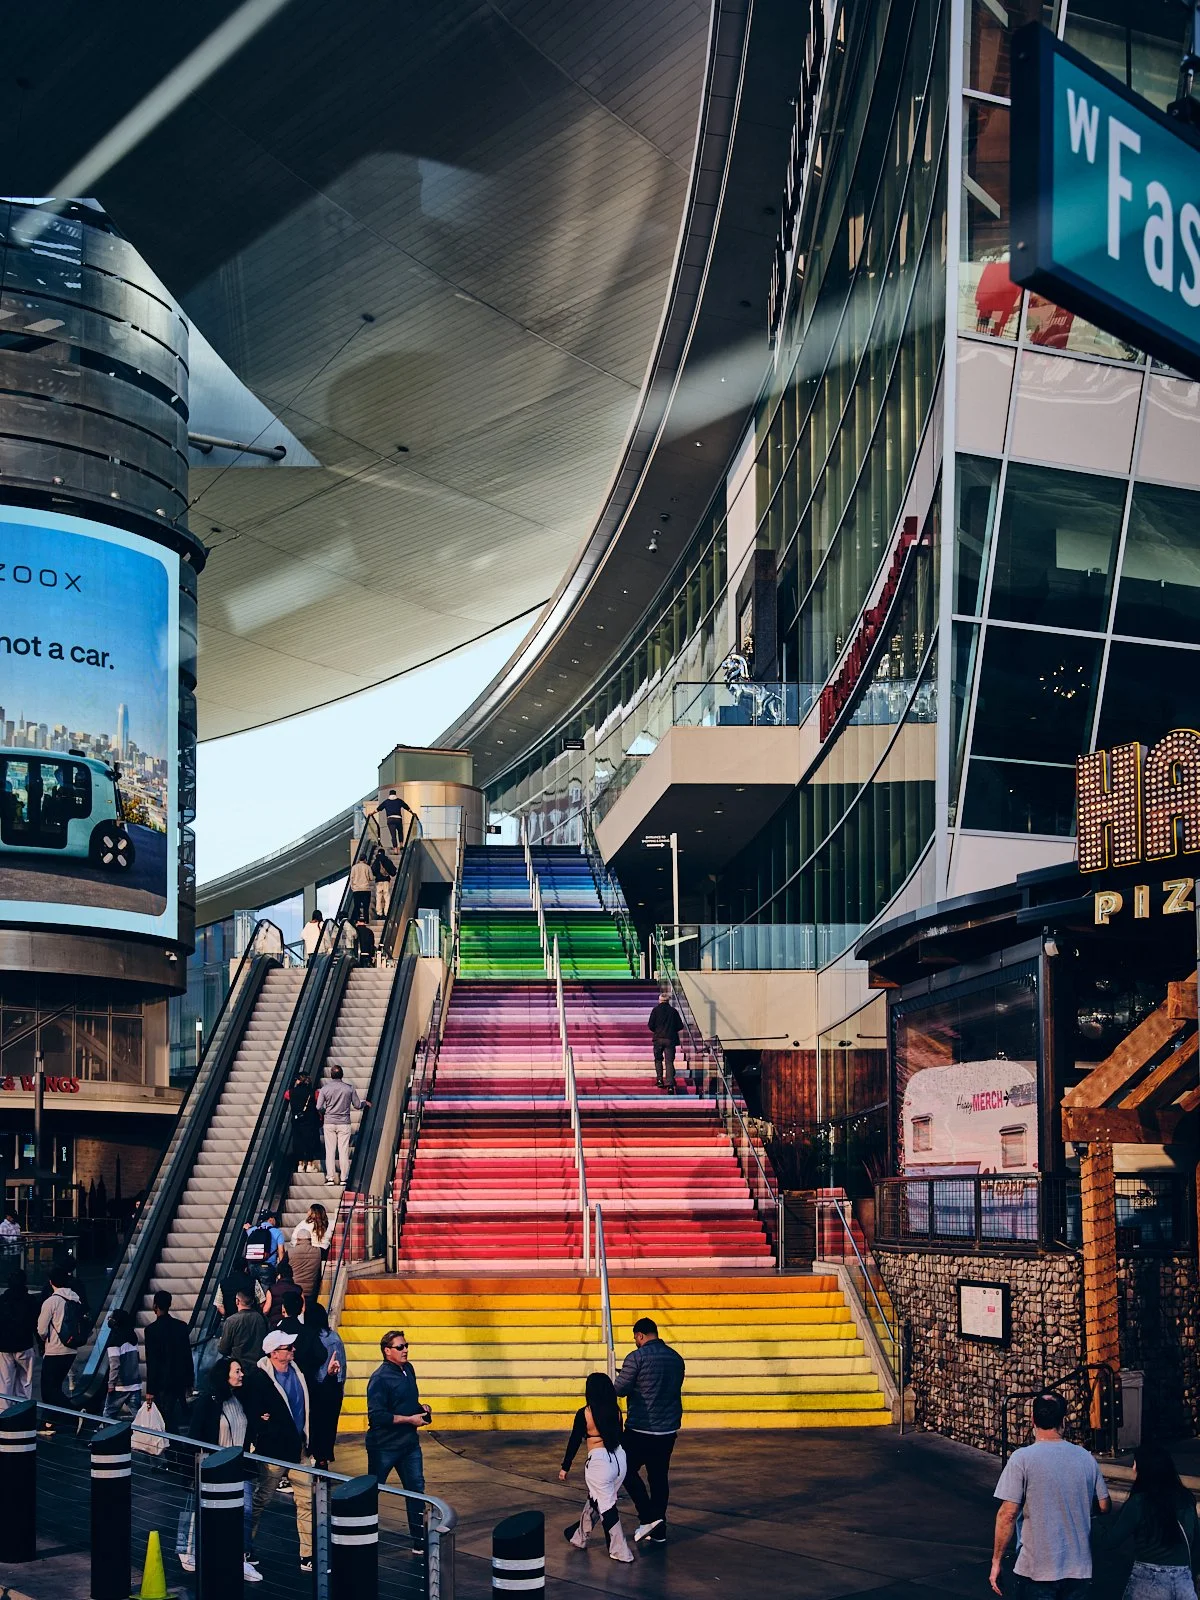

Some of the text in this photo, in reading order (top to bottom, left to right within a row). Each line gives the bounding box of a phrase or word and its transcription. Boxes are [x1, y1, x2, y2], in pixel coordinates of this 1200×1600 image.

[1066, 87, 1100, 165] W
[48, 642, 65, 661] a
[70, 645, 115, 670] car.
[1094, 878, 1195, 925] PIZ
[21, 1075, 80, 1094] WNGS
[972, 1090, 1004, 1112] MERCH
